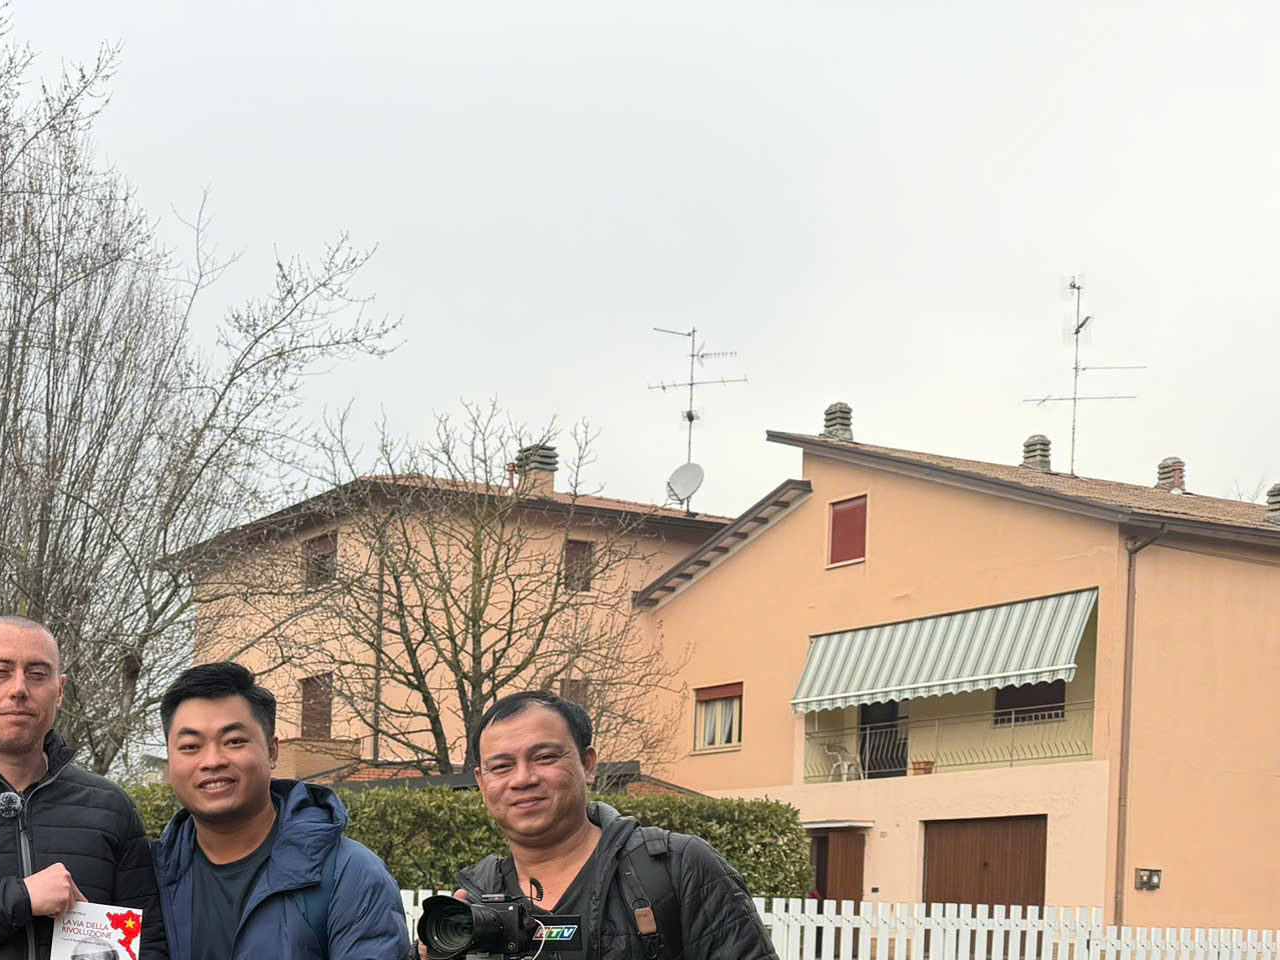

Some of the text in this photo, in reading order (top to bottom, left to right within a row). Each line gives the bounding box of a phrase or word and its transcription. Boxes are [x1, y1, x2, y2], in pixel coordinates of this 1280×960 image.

[72, 919, 84, 928] VIA
[86, 921, 109, 931] DELLA
[61, 926, 112, 939] RIVOLUZIONE
[536, 928, 574, 937] HTV
